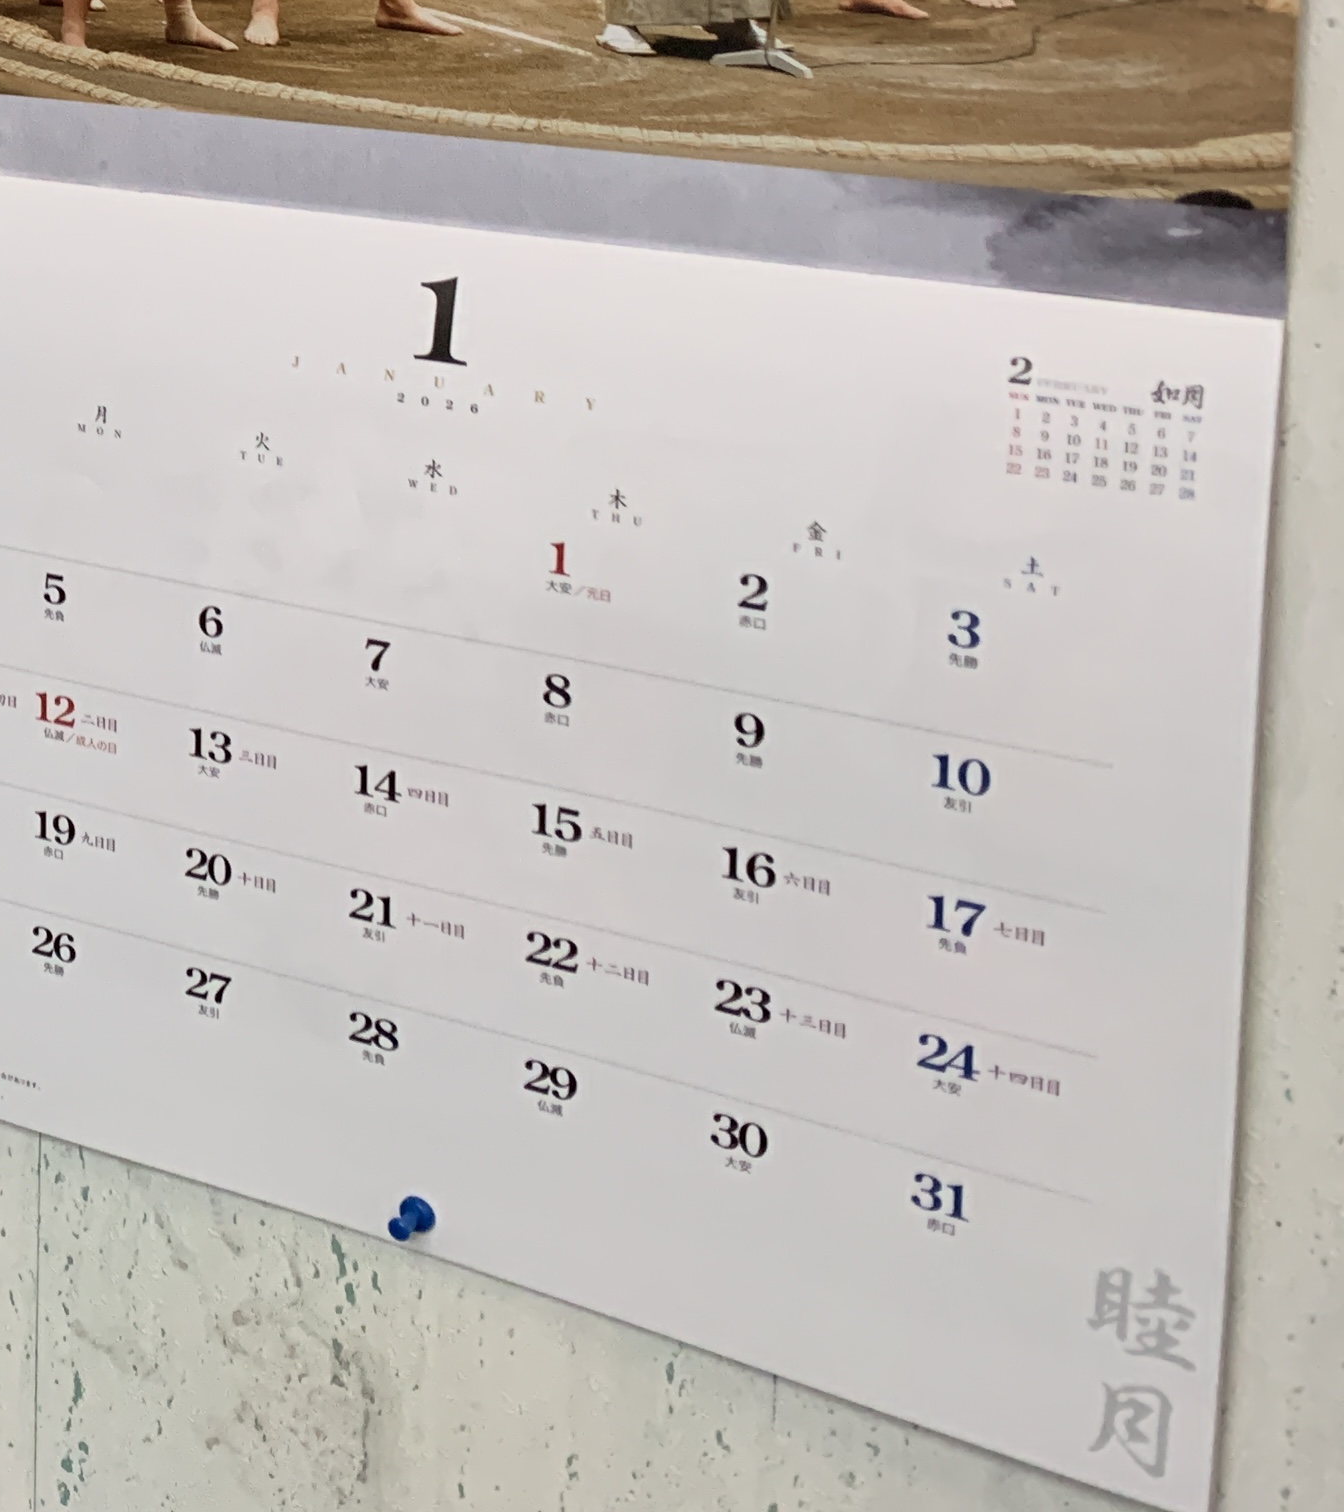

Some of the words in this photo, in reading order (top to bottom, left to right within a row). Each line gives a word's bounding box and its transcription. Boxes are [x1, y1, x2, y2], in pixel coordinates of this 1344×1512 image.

[414, 277, 467, 366] 1
[1008, 356, 1033, 385] 2
[96, 406, 107, 424] 月
[397, 393, 478, 414] 2026
[256, 432, 269, 451] 火
[1067, 434, 1082, 447] 10
[1095, 437, 1108, 450] 11
[1124, 442, 1138, 454] 12
[1153, 446, 1168, 458] 13
[1183, 450, 1197, 462] 14
[425, 459, 442, 478] 水
[611, 489, 626, 509] 木
[808, 521, 827, 542] 金
[550, 542, 569, 577] 1
[1022, 556, 1043, 576] 土
[44, 573, 66, 605] 5
[738, 574, 768, 611] 2
[44, 608, 65, 623] 先負
[199, 606, 223, 638] 6
[738, 615, 767, 632] 赤口
[948, 610, 980, 648] 3
[199, 641, 223, 656] 仏滅
[365, 638, 390, 671] 7
[948, 653, 979, 670] 先勝
[365, 676, 390, 692] 大安
[543, 674, 571, 708] 8
[36, 692, 75, 728] 12
[543, 712, 570, 728] 赤口
[81, 715, 118, 734] 二日目
[734, 713, 765, 748] 9
[190, 728, 232, 763] 13
[198, 765, 221, 779] 大安
[238, 750, 277, 771] 三日目
[735, 753, 764, 769] 先勝
[355, 765, 401, 803] 14
[933, 754, 991, 796] 10
[406, 788, 449, 808] 四日目
[943, 796, 972, 814] 友引
[363, 802, 388, 818] 赤口
[36, 811, 75, 845] 19
[532, 804, 582, 842] 15
[81, 832, 116, 853] 九日目
[590, 827, 633, 850] 五日目
[43, 846, 64, 861] 赤口
[541, 843, 568, 858] 先勝
[185, 848, 231, 885] 20
[723, 847, 776, 888] 16
[197, 886, 220, 901] 先勝
[237, 872, 276, 894] 十日目
[783, 872, 831, 897] 六日目
[732, 888, 760, 905] 友引
[349, 889, 395, 928] 21
[928, 896, 986, 937] 17
[362, 928, 385, 943] 友引
[406, 913, 465, 940] 十一日目
[993, 922, 1046, 947] 七日目
[32, 926, 76, 963] 26
[526, 932, 578, 973] 22
[938, 938, 967, 956] 先負
[43, 963, 65, 977] 先勝
[539, 972, 565, 989] 先負
[586, 957, 650, 987] 十二日目
[186, 968, 232, 1004] 27
[198, 1004, 220, 1020] 友引
[715, 980, 771, 1023] 23
[349, 1012, 399, 1051] 28
[728, 1022, 757, 1040] 仏滅
[780, 1008, 847, 1040] 十三日目
[362, 1050, 386, 1067] 先負
[917, 1034, 979, 1081] 24
[524, 1060, 577, 1100] 29
[932, 1079, 962, 1097] 大安
[987, 1065, 1061, 1097] 十四日目
[537, 1100, 564, 1118] 仏滅
[711, 1113, 768, 1158] 30
[724, 1157, 752, 1175] 大安
[911, 1173, 968, 1221] 31
[926, 1218, 956, 1237] 赤口
[1087, 1267, 1196, 1478] 睦月
